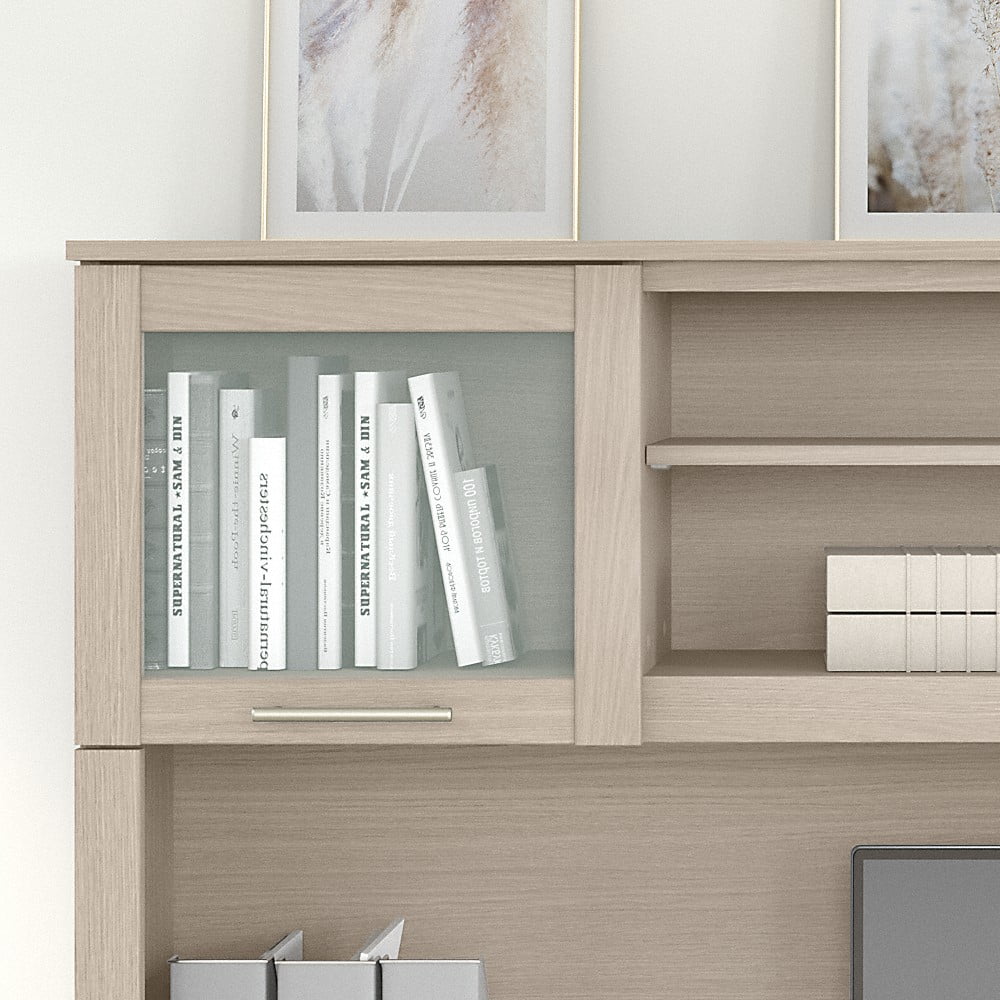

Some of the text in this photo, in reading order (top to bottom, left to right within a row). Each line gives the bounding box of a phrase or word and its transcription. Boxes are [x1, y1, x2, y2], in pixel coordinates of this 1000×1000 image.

[172, 415, 183, 441] DIN
[359, 415, 370, 441] DIN
[172, 445, 183, 455] &
[359, 445, 370, 455] &
[172, 504, 183, 616] SUPERNATURAL
[359, 504, 370, 616] SUPERNATURAL
